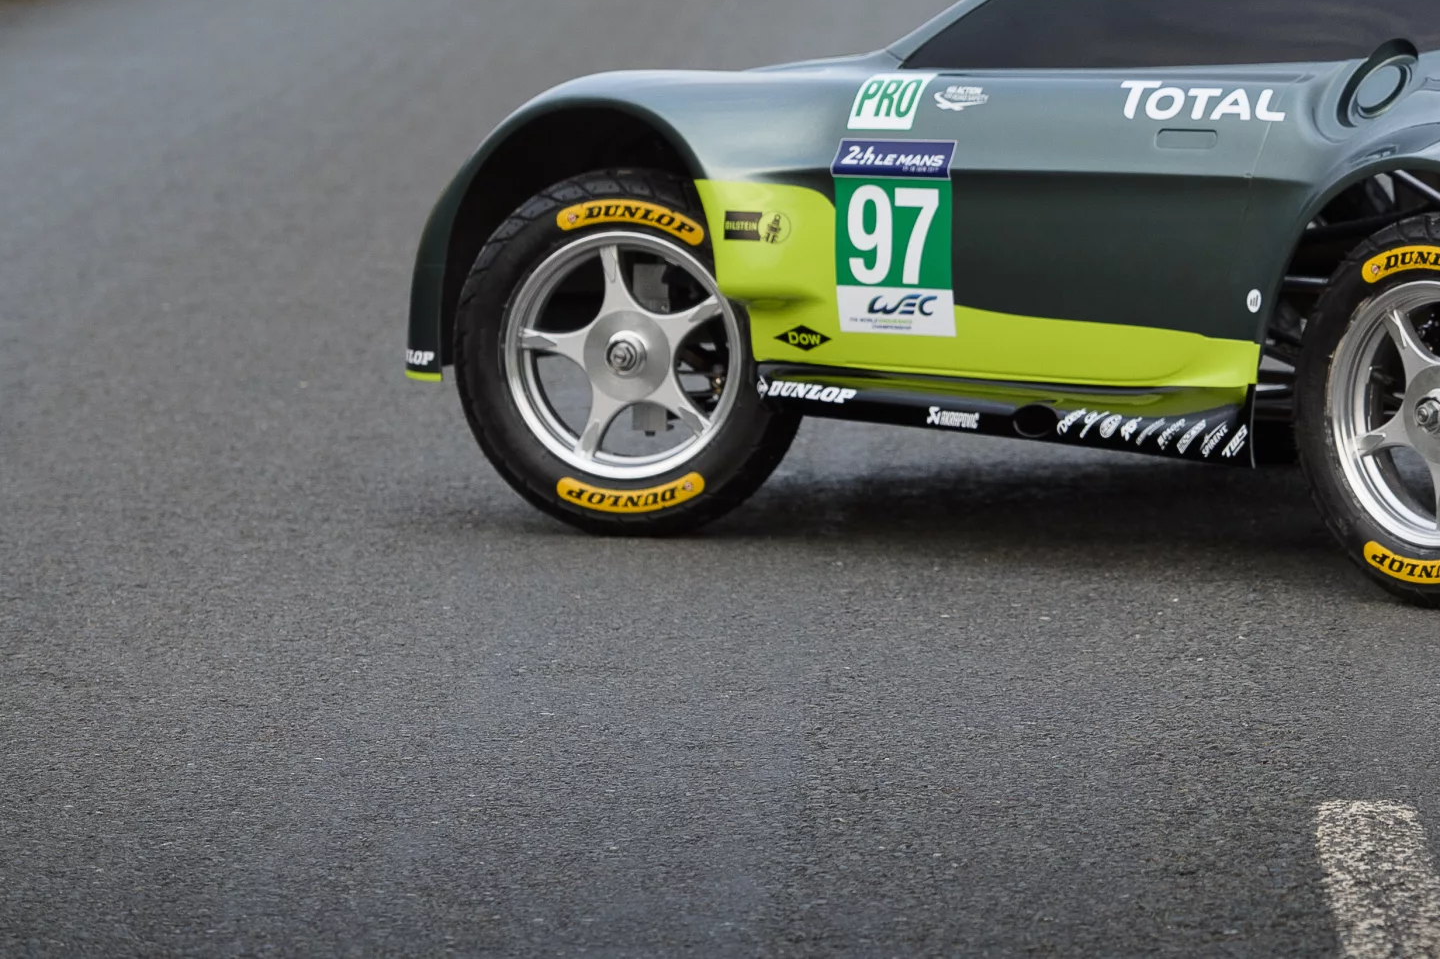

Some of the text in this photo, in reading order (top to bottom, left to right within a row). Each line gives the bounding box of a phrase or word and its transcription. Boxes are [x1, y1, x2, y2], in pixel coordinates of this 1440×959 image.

[855, 78, 923, 118] PRO
[1120, 80, 1286, 122] TOTAL
[873, 153, 898, 166] LE
[895, 153, 946, 167] MANS
[584, 205, 695, 234] DUNLOP
[847, 184, 940, 285] 97
[867, 293, 938, 317] WEC
[787, 331, 821, 346] DOW
[767, 380, 858, 404] DUNLOP
[566, 487, 678, 508] DUNLOP
